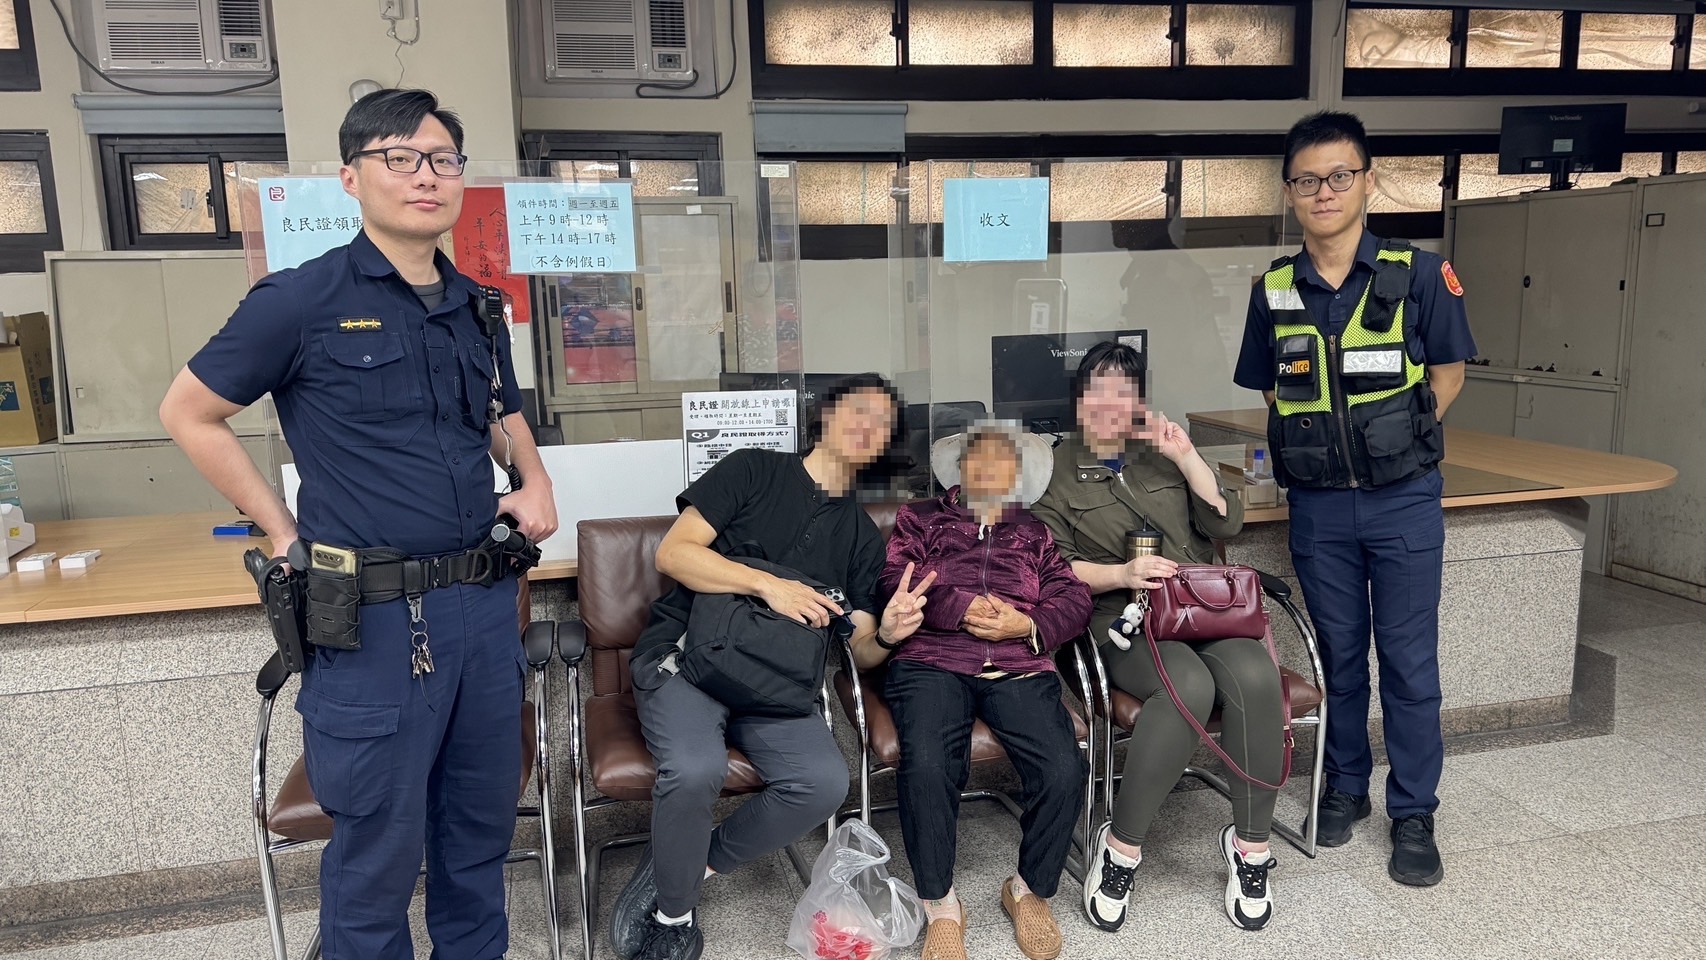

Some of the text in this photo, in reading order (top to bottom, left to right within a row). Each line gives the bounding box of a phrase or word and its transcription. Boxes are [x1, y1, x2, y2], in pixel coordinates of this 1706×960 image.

[282, 217, 364, 232] 良民證領取
[980, 212, 1011, 227] 收文
[1050, 348, 1088, 358] ViewSoni
[1279, 361, 1309, 374] Police
